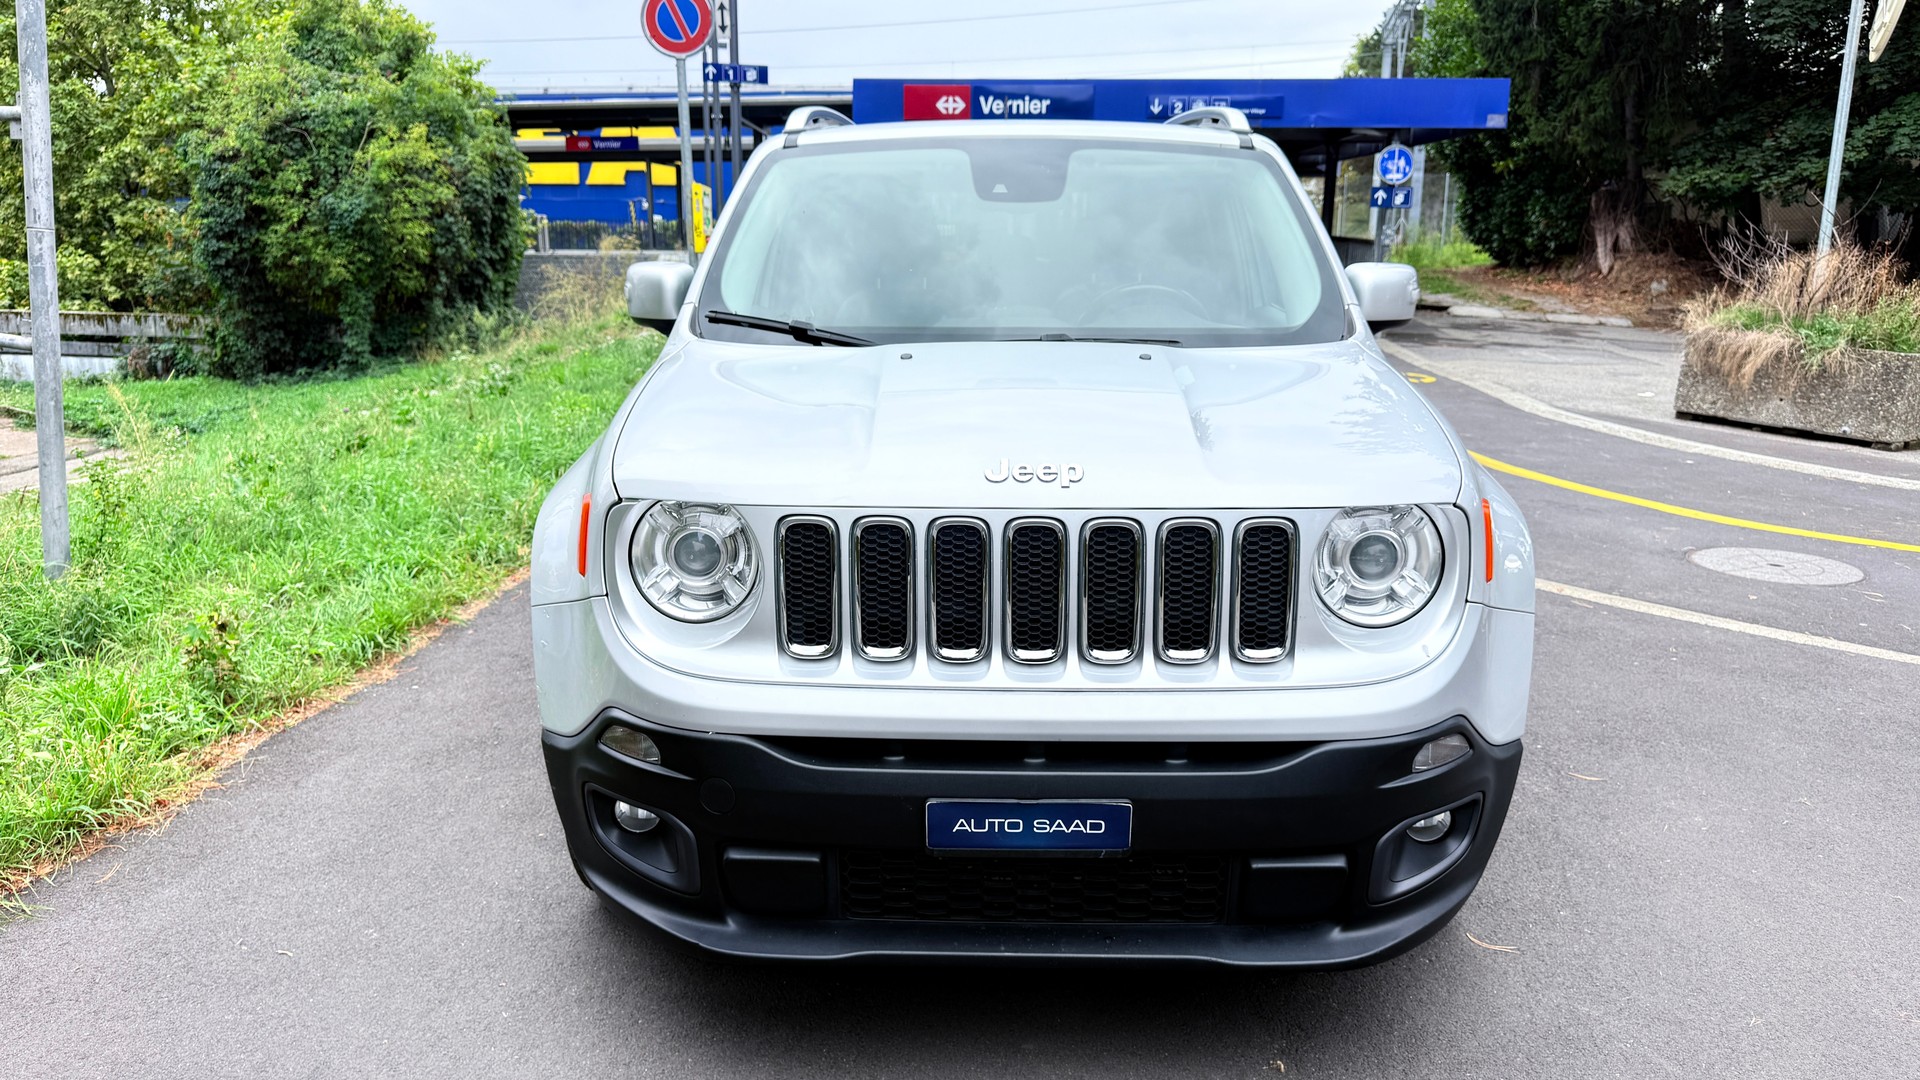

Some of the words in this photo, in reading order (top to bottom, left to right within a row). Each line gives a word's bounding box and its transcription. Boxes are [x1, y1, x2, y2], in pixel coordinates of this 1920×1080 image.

[979, 94, 1051, 115] Vernier
[1173, 101, 1184, 115] 2
[592, 140, 621, 149] Vernier
[983, 457, 1085, 489] Jeep
[952, 818, 1024, 833] AUTO
[1032, 818, 1106, 834] SAAD
